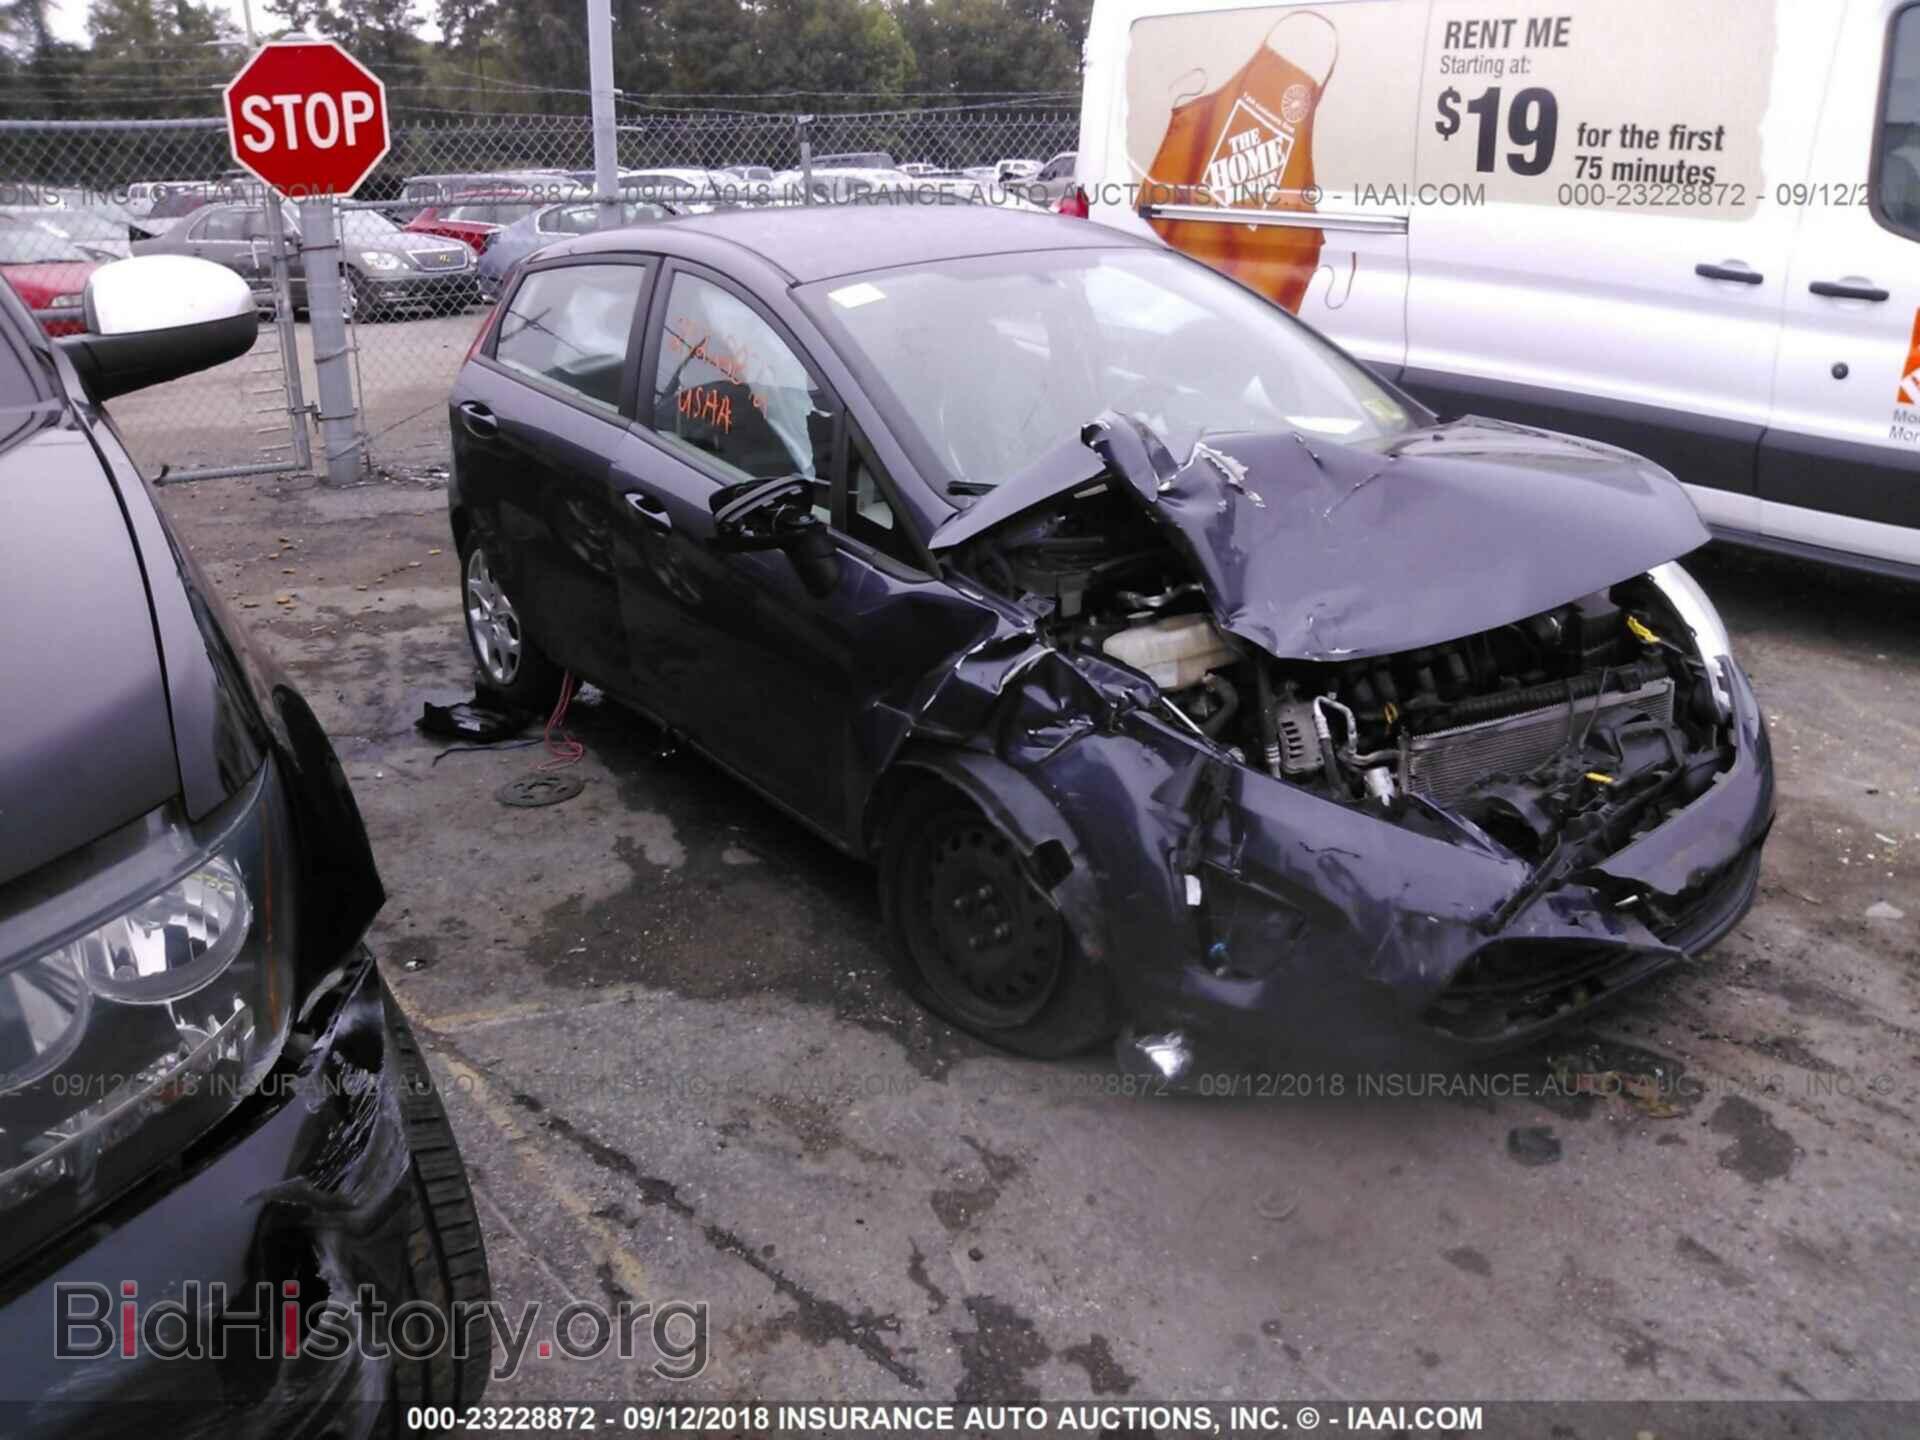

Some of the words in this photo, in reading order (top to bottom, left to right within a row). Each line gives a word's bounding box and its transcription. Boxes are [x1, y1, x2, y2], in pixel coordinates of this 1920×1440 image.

[1444, 20, 1516, 50] RENT
[1525, 16, 1572, 49] ME
[1440, 55, 1504, 78] Starting
[1509, 56, 1532, 75] at:
[241, 91, 375, 154] STOP
[1435, 86, 1559, 177] $19
[1576, 123, 1611, 148] for
[1619, 124, 1659, 150] the
[1668, 124, 1725, 152] first
[1228, 127, 1260, 153] THE
[1210, 135, 1286, 190] HOME
[1574, 156, 1603, 181] 75
[1611, 158, 1716, 187] minutes
